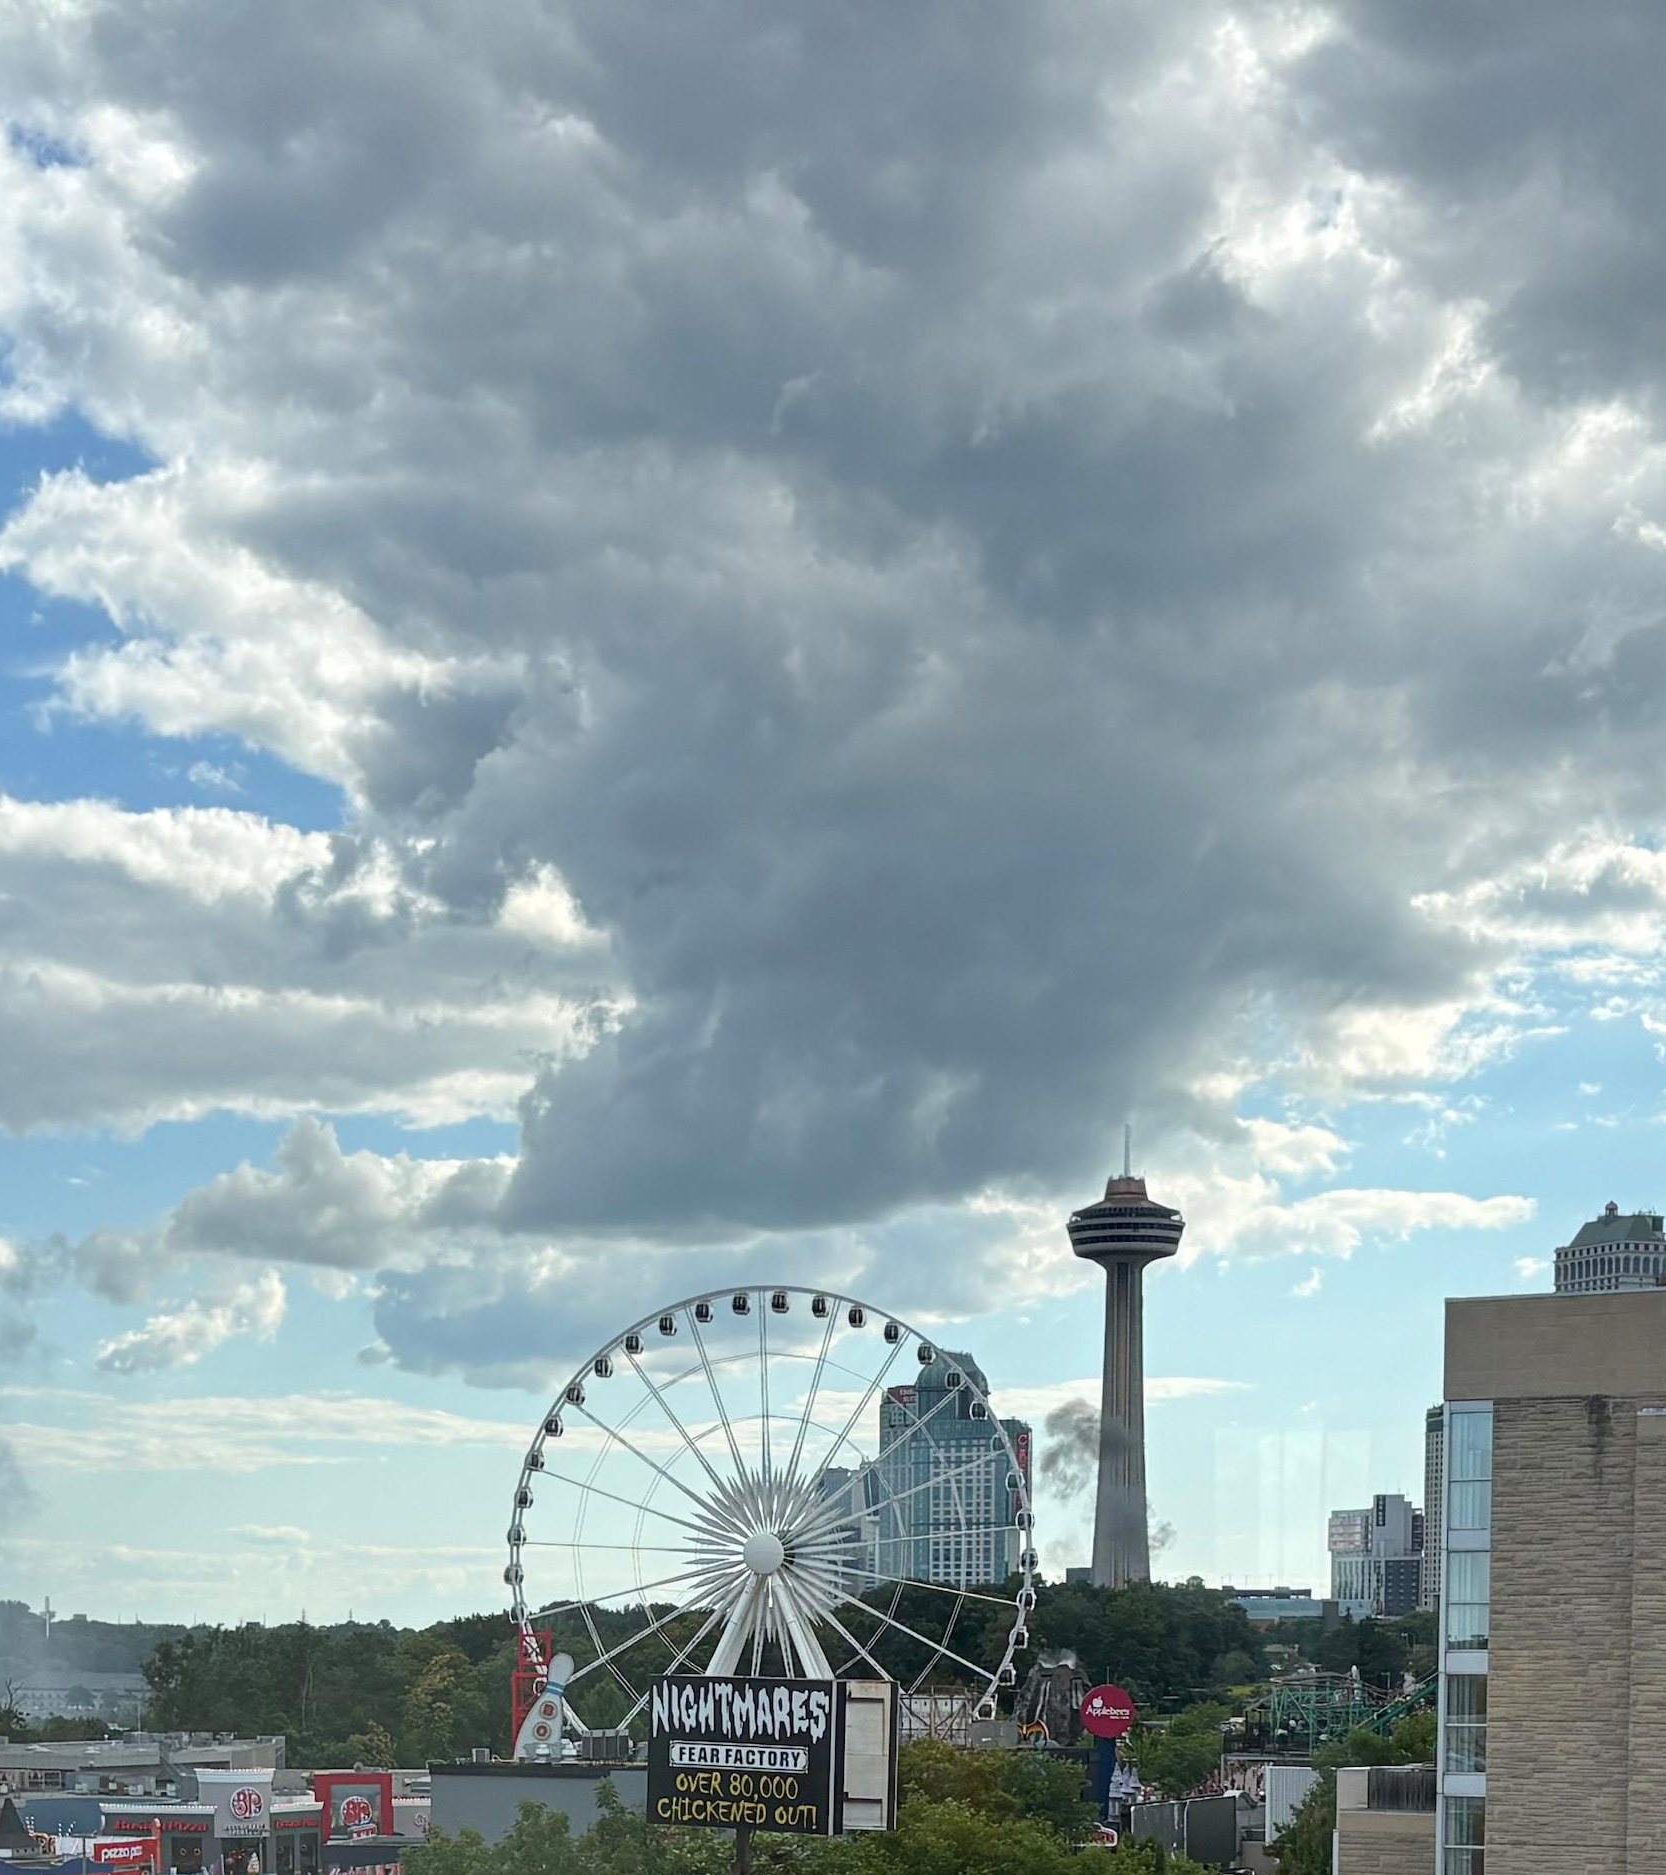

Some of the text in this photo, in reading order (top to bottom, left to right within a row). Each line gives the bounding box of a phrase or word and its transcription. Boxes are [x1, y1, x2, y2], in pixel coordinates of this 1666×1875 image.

[651, 1679, 830, 1745] NIGHTMARES
[678, 1746, 801, 1768] FEAR FACTORY
[675, 1772, 799, 1801] OVER 80,000
[657, 1797, 818, 1830] CHICKENED OUT!
